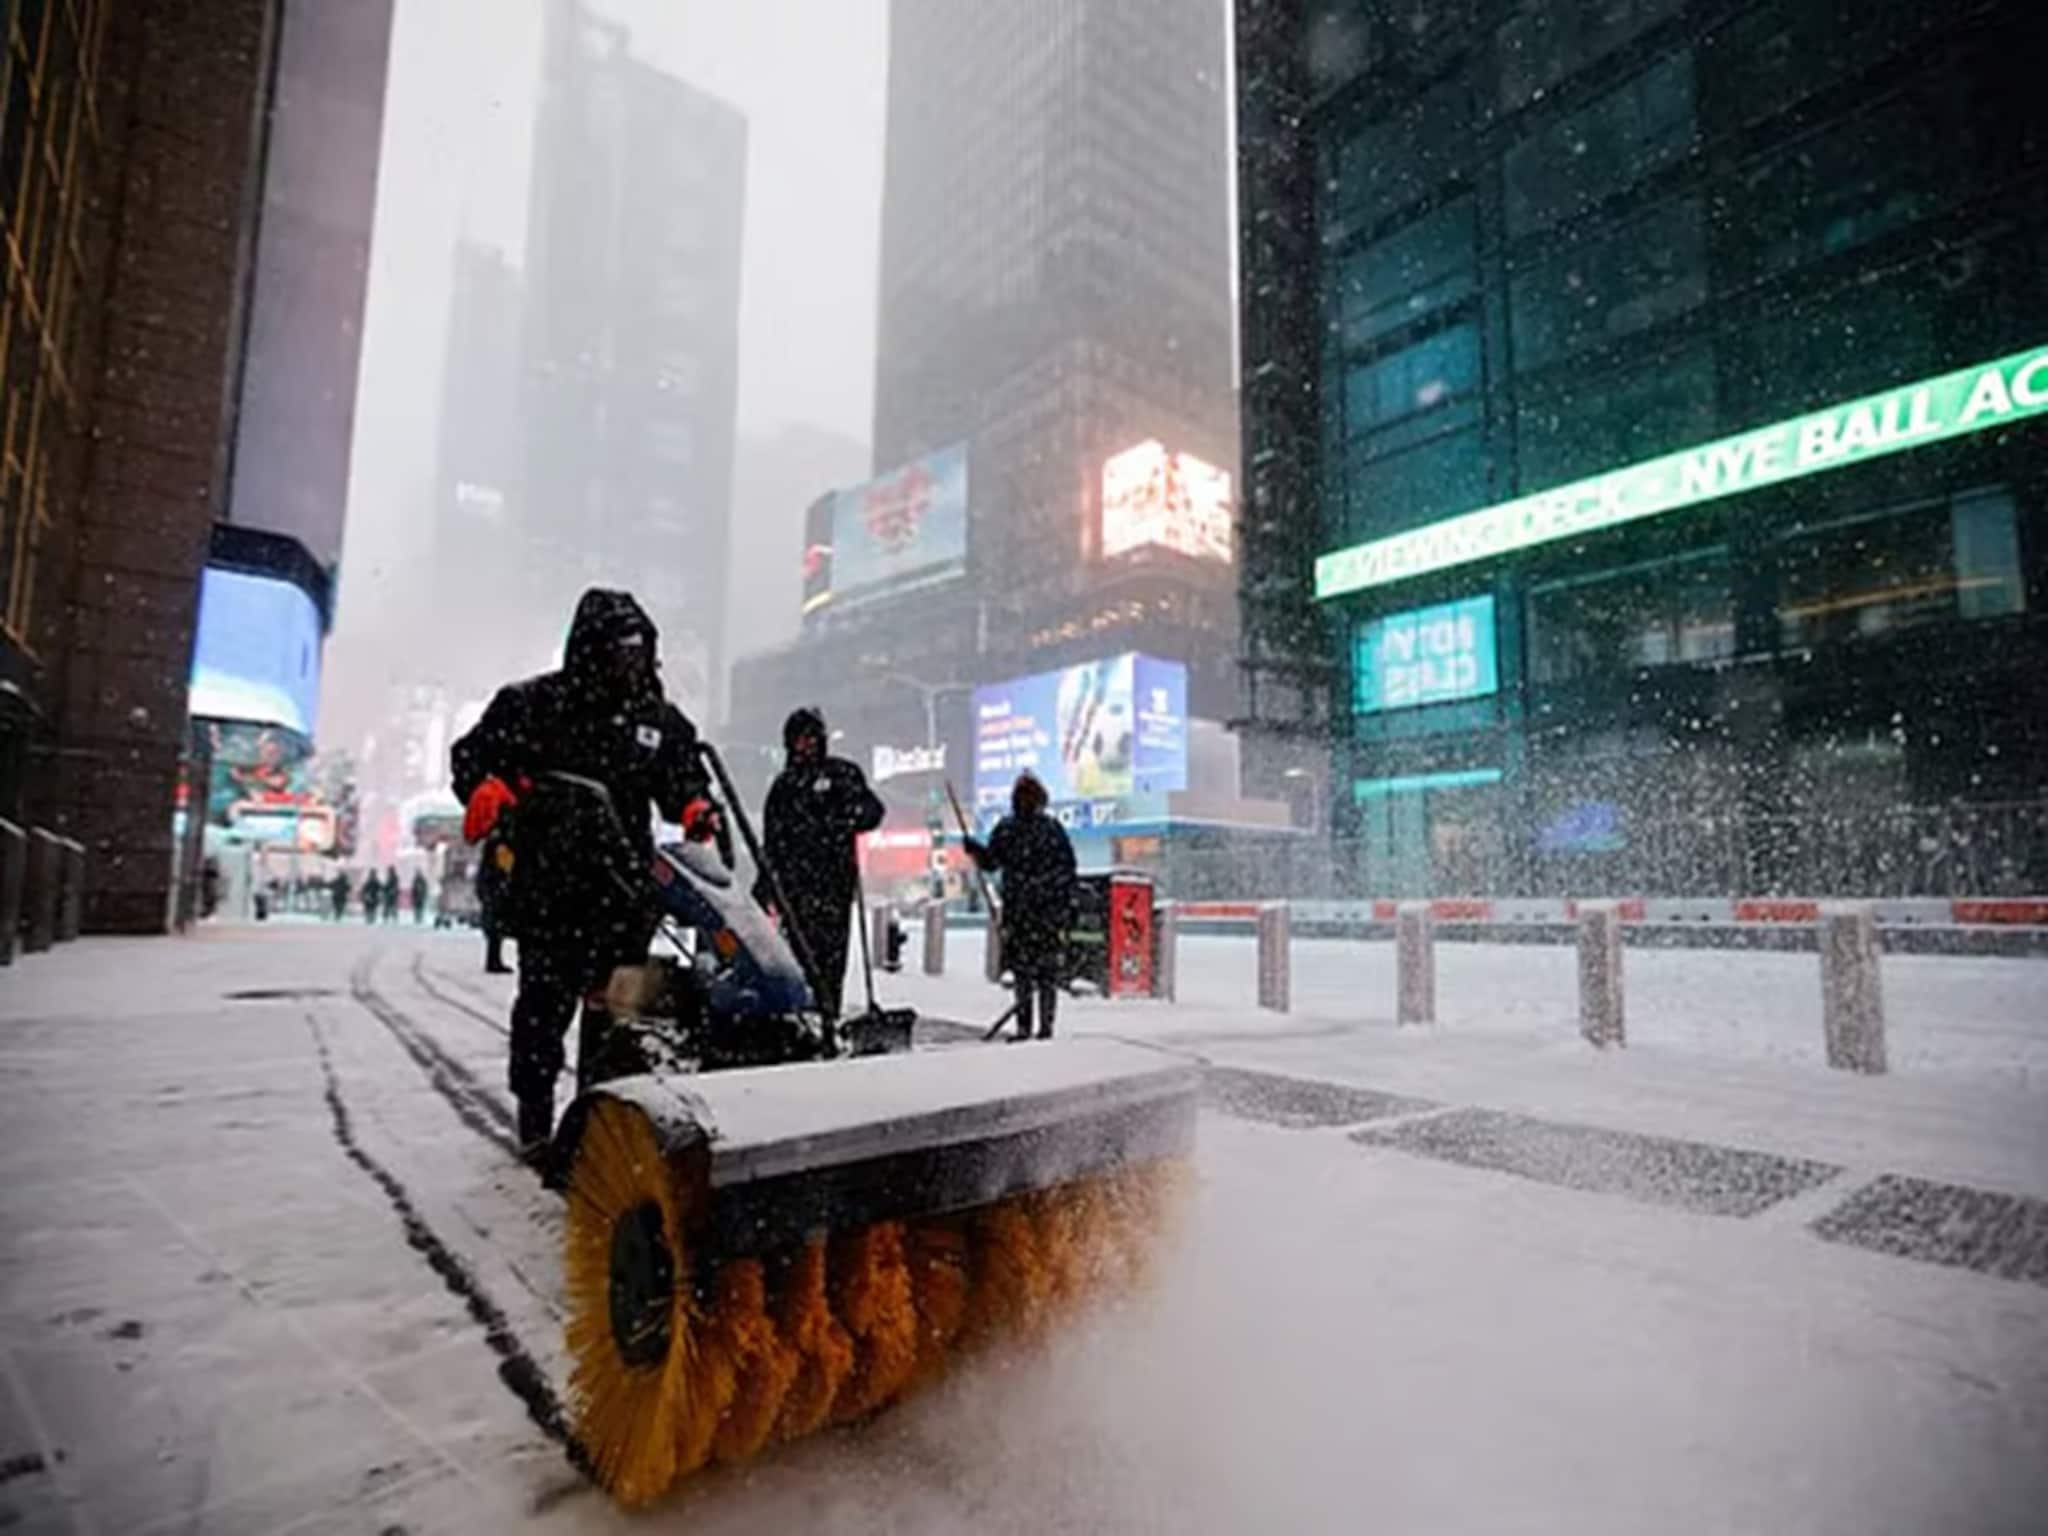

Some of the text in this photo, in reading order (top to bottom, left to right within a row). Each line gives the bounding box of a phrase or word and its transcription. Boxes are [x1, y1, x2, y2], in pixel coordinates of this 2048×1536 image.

[1515, 479, 1626, 541] DECK
[1679, 431, 1787, 496] NYE
[1796, 388, 1943, 467] BALL
